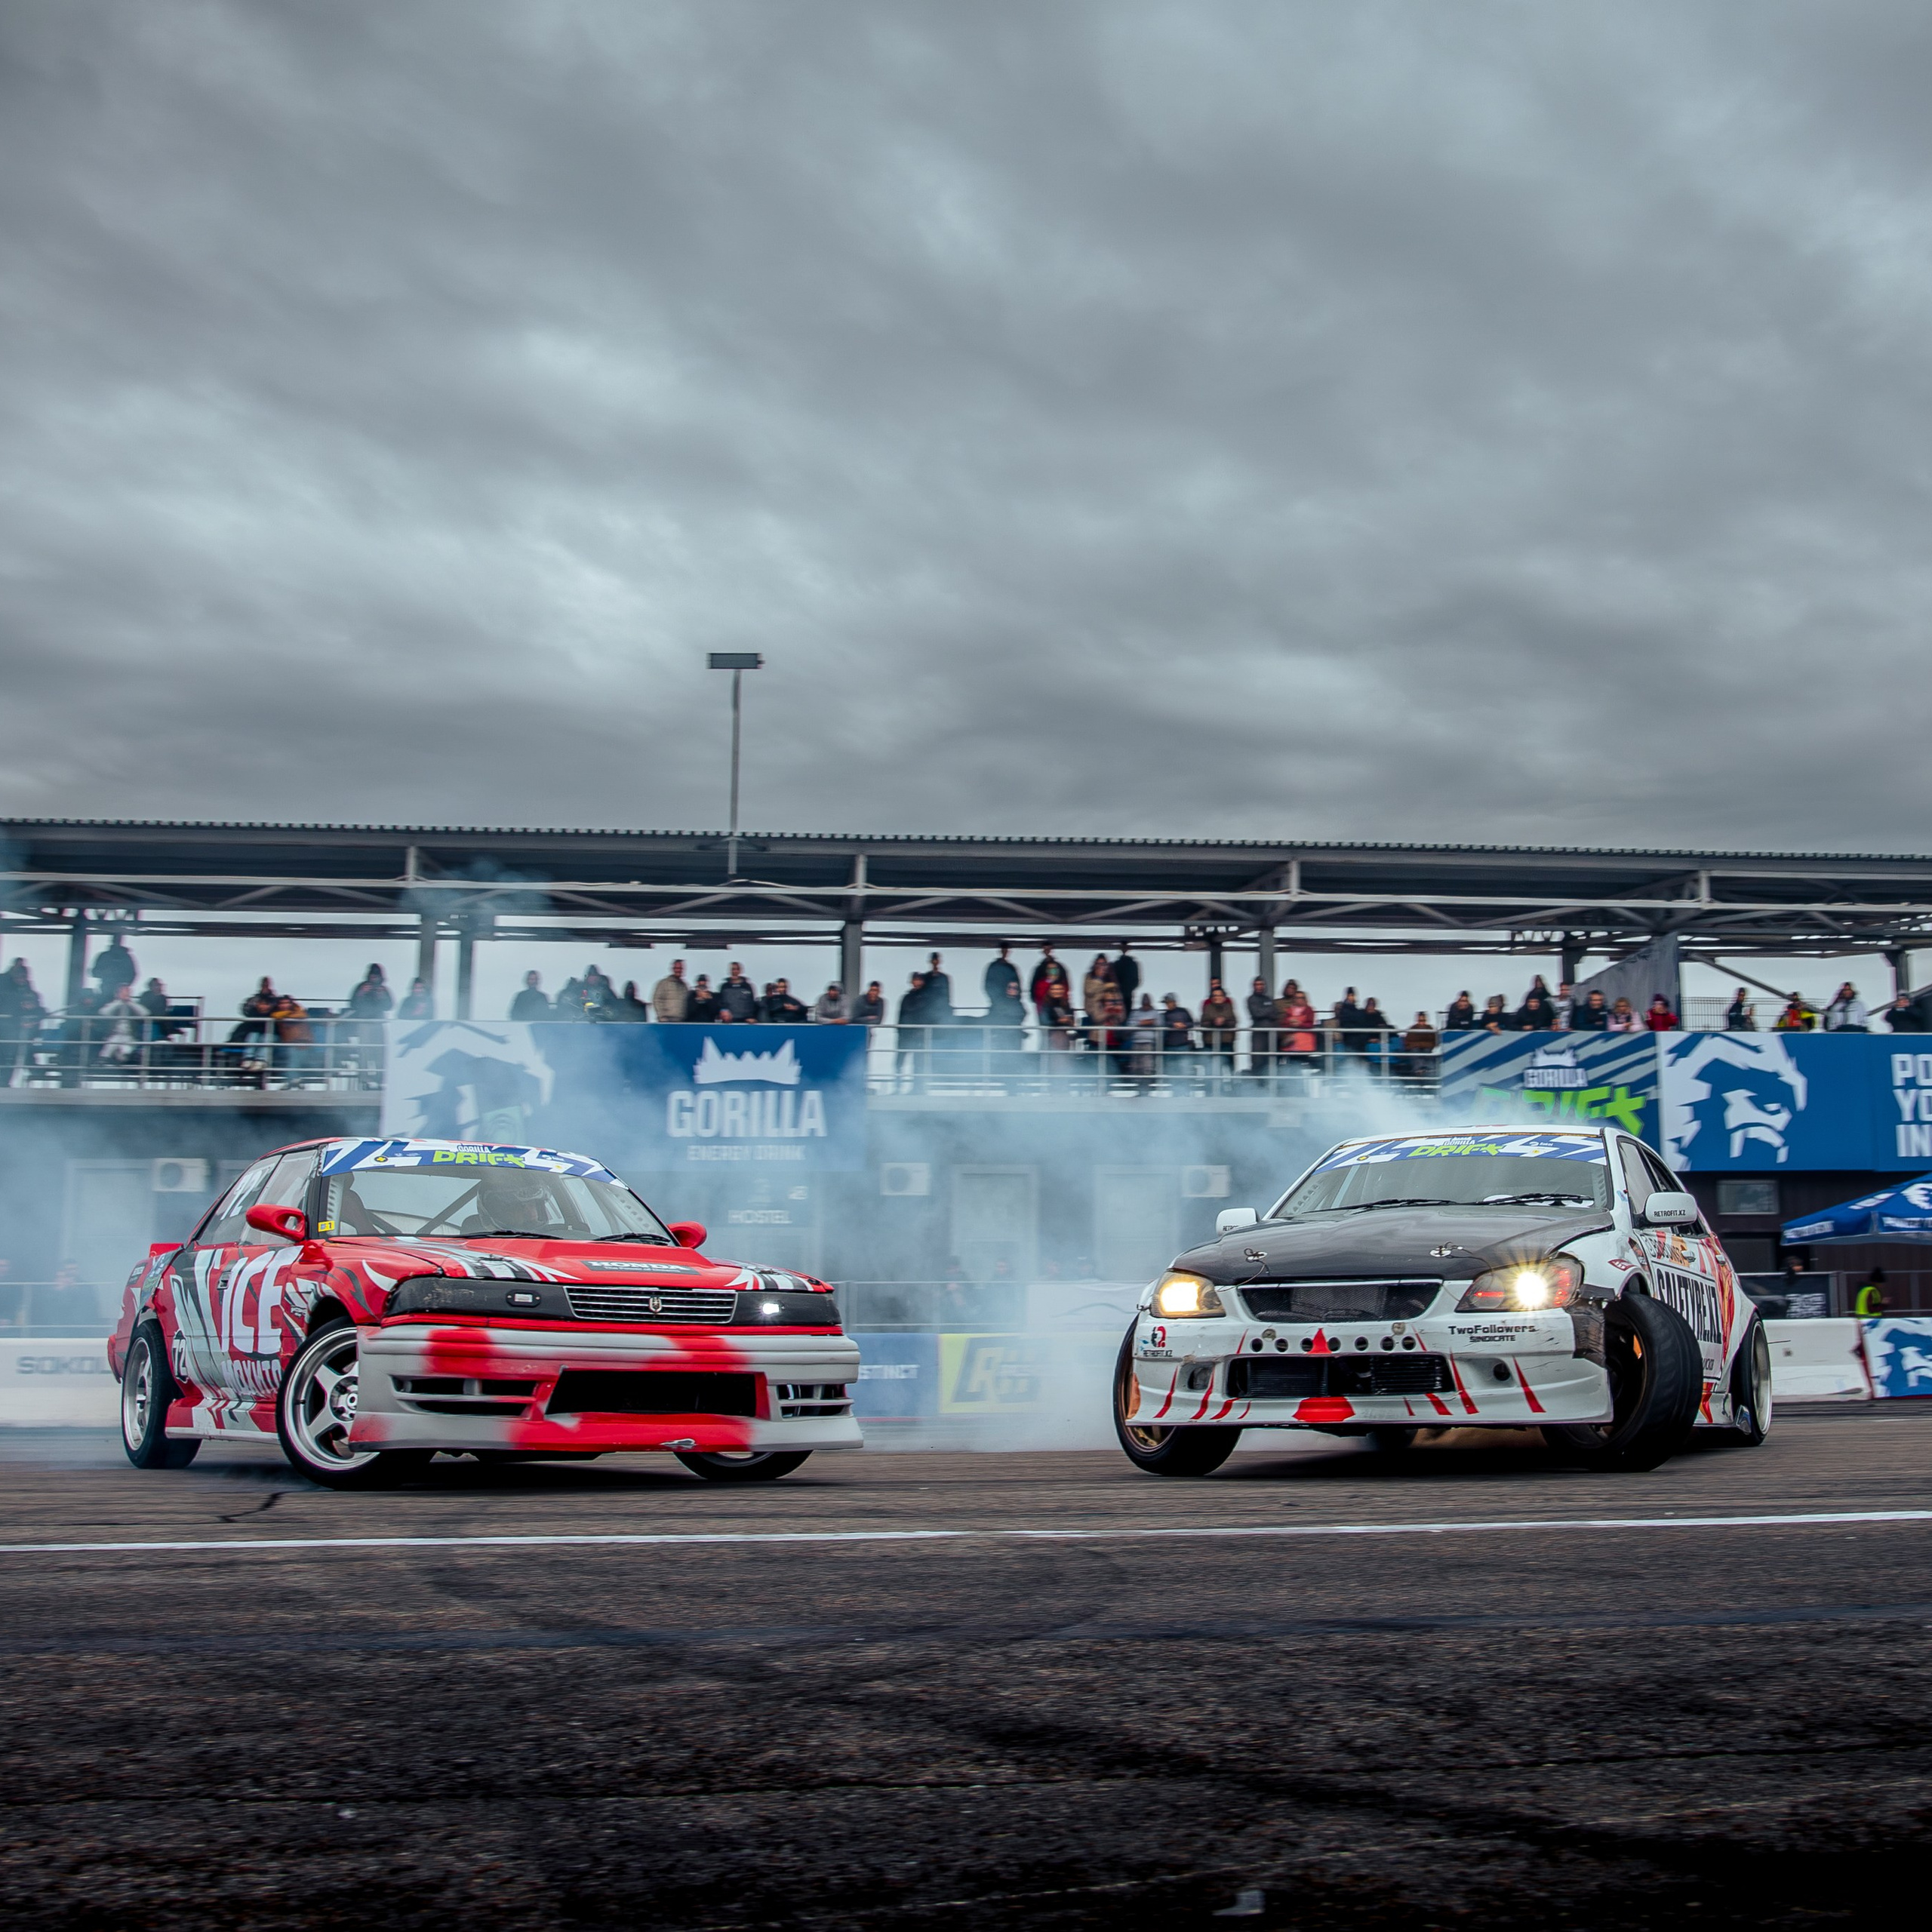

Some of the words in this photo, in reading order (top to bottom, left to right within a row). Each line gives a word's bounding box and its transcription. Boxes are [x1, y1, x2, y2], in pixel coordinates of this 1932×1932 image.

[1523, 1068, 1588, 1088] GORILLA
[667, 1090, 828, 1137] GORILLA
[457, 1145, 491, 1153] GORILLA
[687, 1145, 752, 1161] ENERGY
[753, 1145, 807, 1161] DRINK
[1407, 1143, 1505, 1156] DRIFT
[432, 1150, 525, 1168] DRIFT
[728, 1210, 792, 1224] HOSTEL
[587, 1261, 691, 1271] HONDA
[1447, 1324, 1536, 1334] TwoFollowers
[17, 1356, 112, 1374] SOKOL
[172, 1339, 187, 1379] 72
